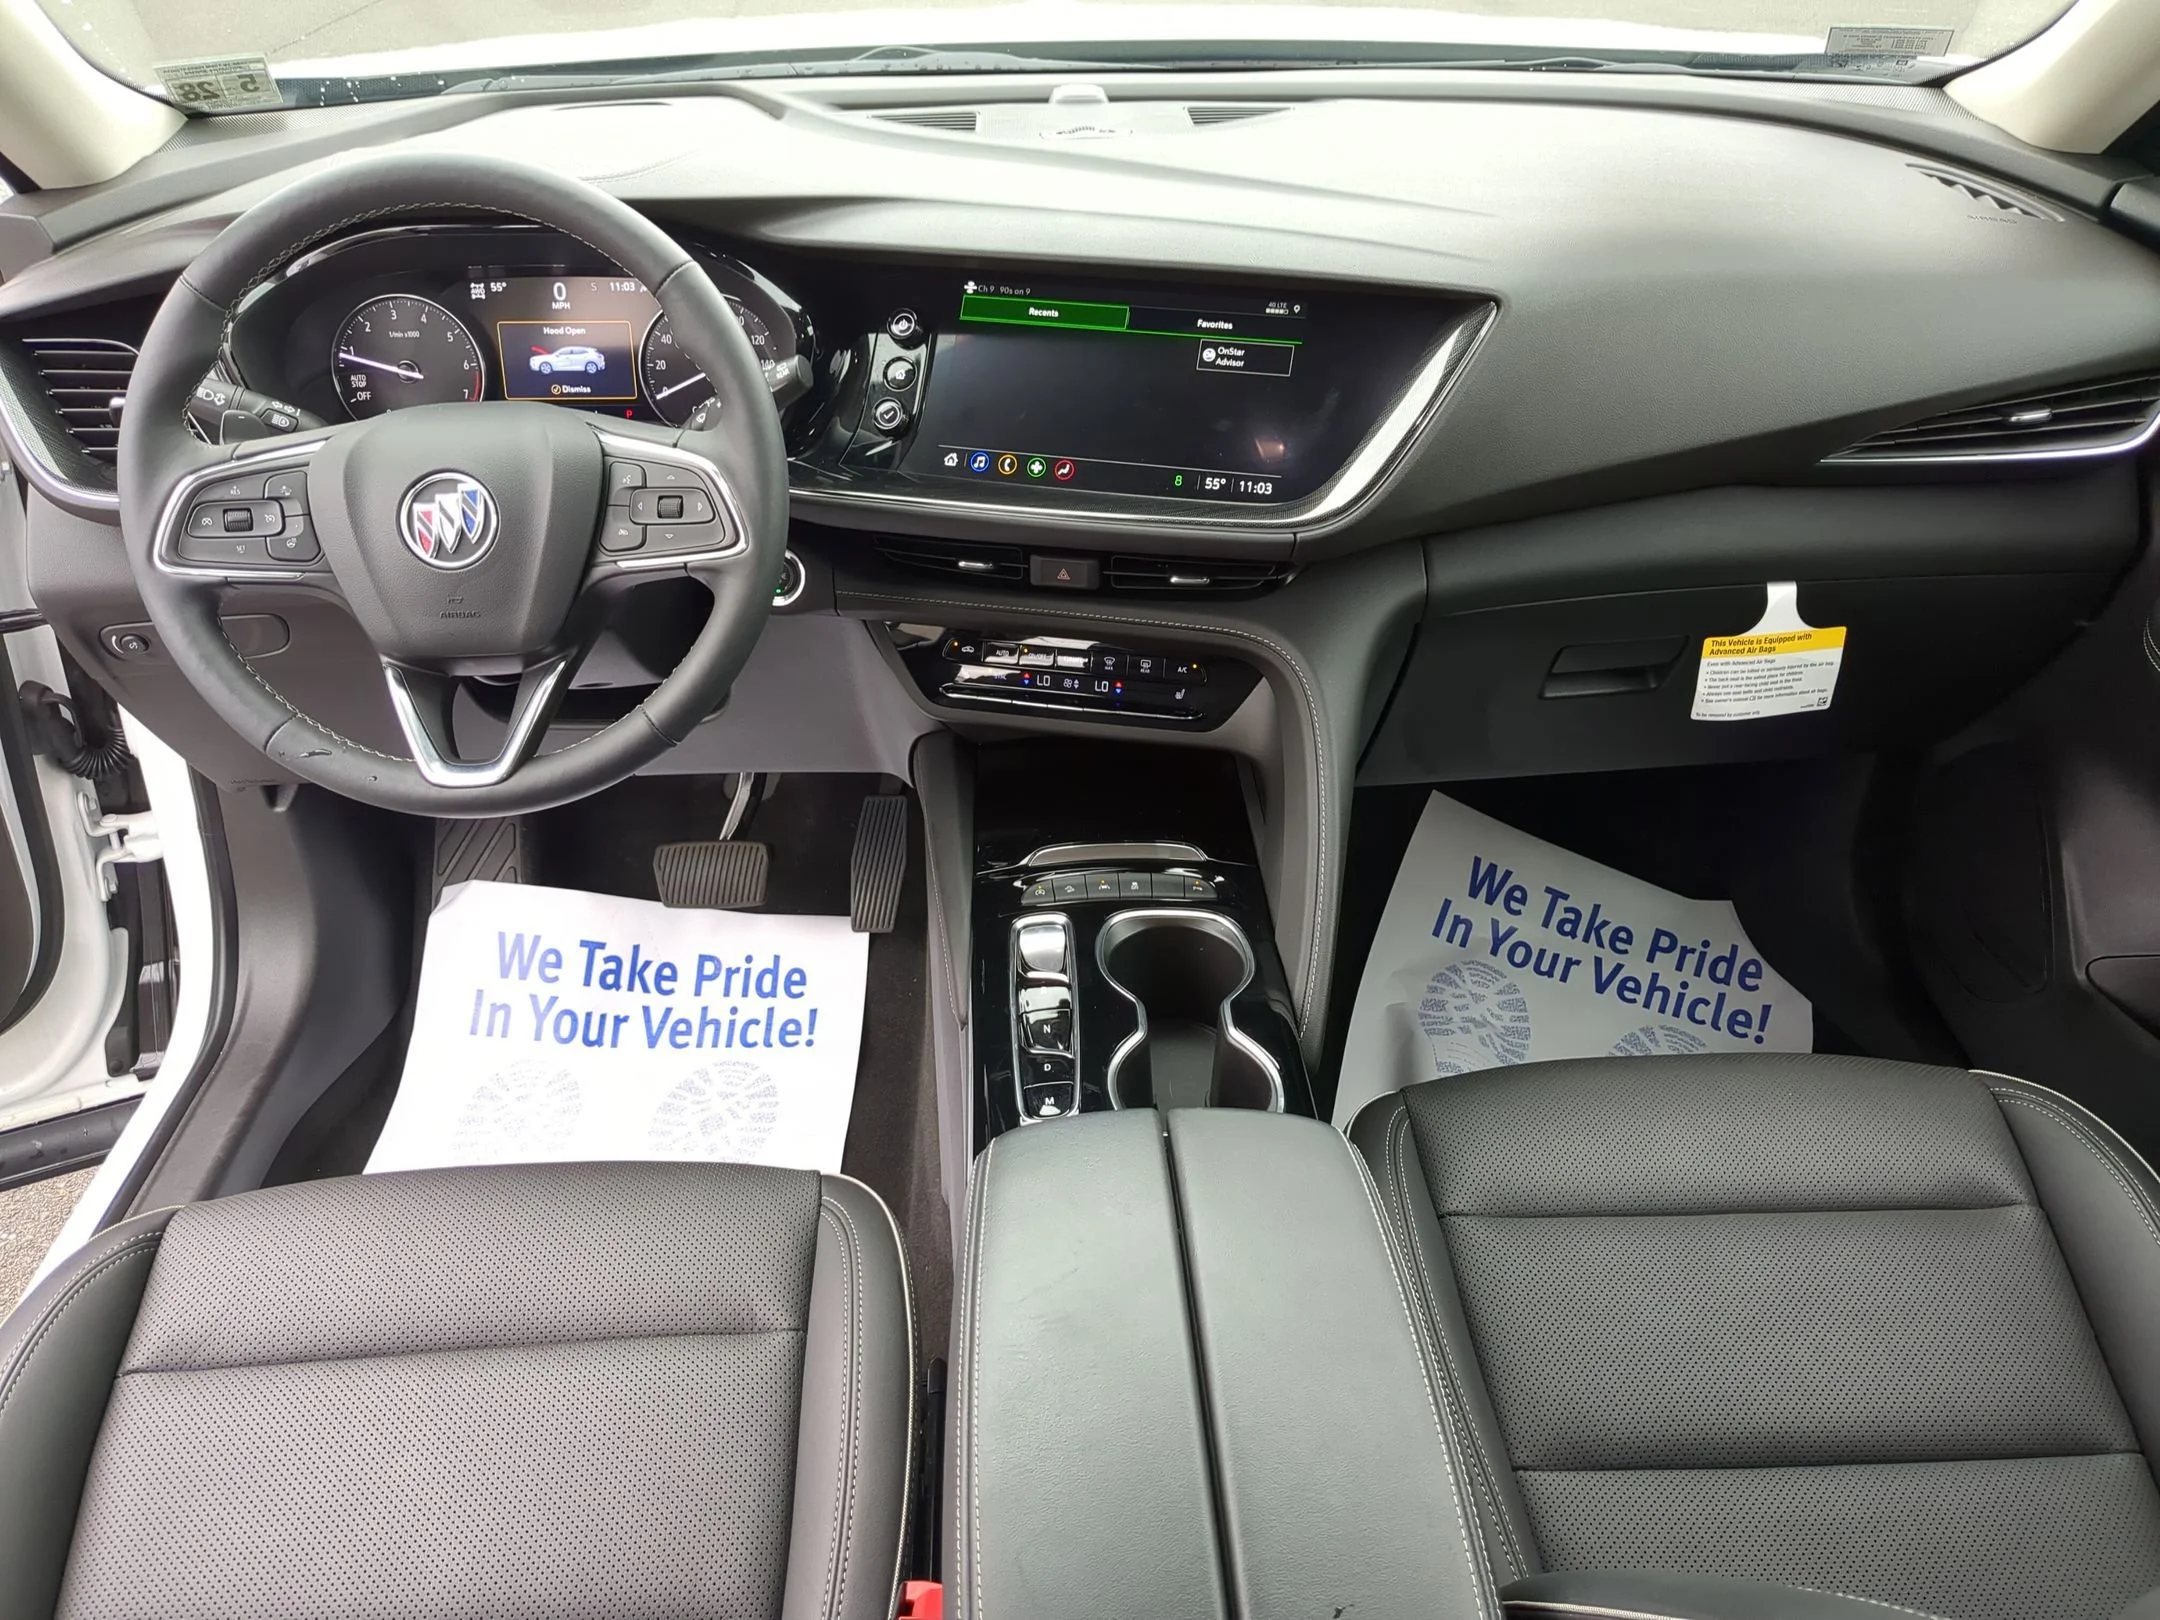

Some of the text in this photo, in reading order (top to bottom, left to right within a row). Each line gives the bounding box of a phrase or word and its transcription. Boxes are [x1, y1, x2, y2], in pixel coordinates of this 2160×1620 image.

[553, 282, 567, 301] 0
[609, 281, 636, 292] 11:03
[978, 285, 988, 293] Ch
[990, 285, 995, 293] 9
[1000, 286, 1013, 295] 90s
[1025, 288, 1031, 297] 9
[551, 301, 571, 310] MPH
[391, 310, 398, 320] 3
[1028, 307, 1059, 318] Recents
[420, 313, 428, 324] 4
[1197, 318, 1233, 330] Favorites
[364, 322, 372, 332] 2
[543, 326, 586, 336] Hood Open
[447, 332, 454, 342] 5
[661, 334, 672, 345] 40
[751, 334, 765, 346] 120
[1217, 346, 1245, 357] OnStar
[463, 360, 470, 370] 6
[655, 359, 667, 371] 20
[1215, 357, 1245, 368] Advisor
[463, 389, 469, 399] 7
[562, 385, 591, 394] Dismiss
[357, 391, 372, 401] OFF
[626, 409, 633, 419] P
[1174, 475, 1273, 495] 8 55° 11:03
[1711, 633, 1812, 647] This Vehicle is Equipped with
[1709, 645, 1776, 655] Advanced Air Bags
[1177, 666, 1188, 674] A/C
[1036, 674, 1051, 687] LO
[1094, 680, 1109, 693] LO
[1467, 855, 1763, 992] We Take Pride
[498, 931, 807, 999] We Take Pride
[1431, 898, 1474, 948] In
[1489, 918, 1581, 983] Your
[1593, 957, 1772, 1044] Vehicle!
[469, 989, 818, 1049] In Your Vehicle!
[1043, 1024, 1051, 1034] N
[1044, 1063, 1052, 1072] D
[1045, 1096, 1055, 1106] M
